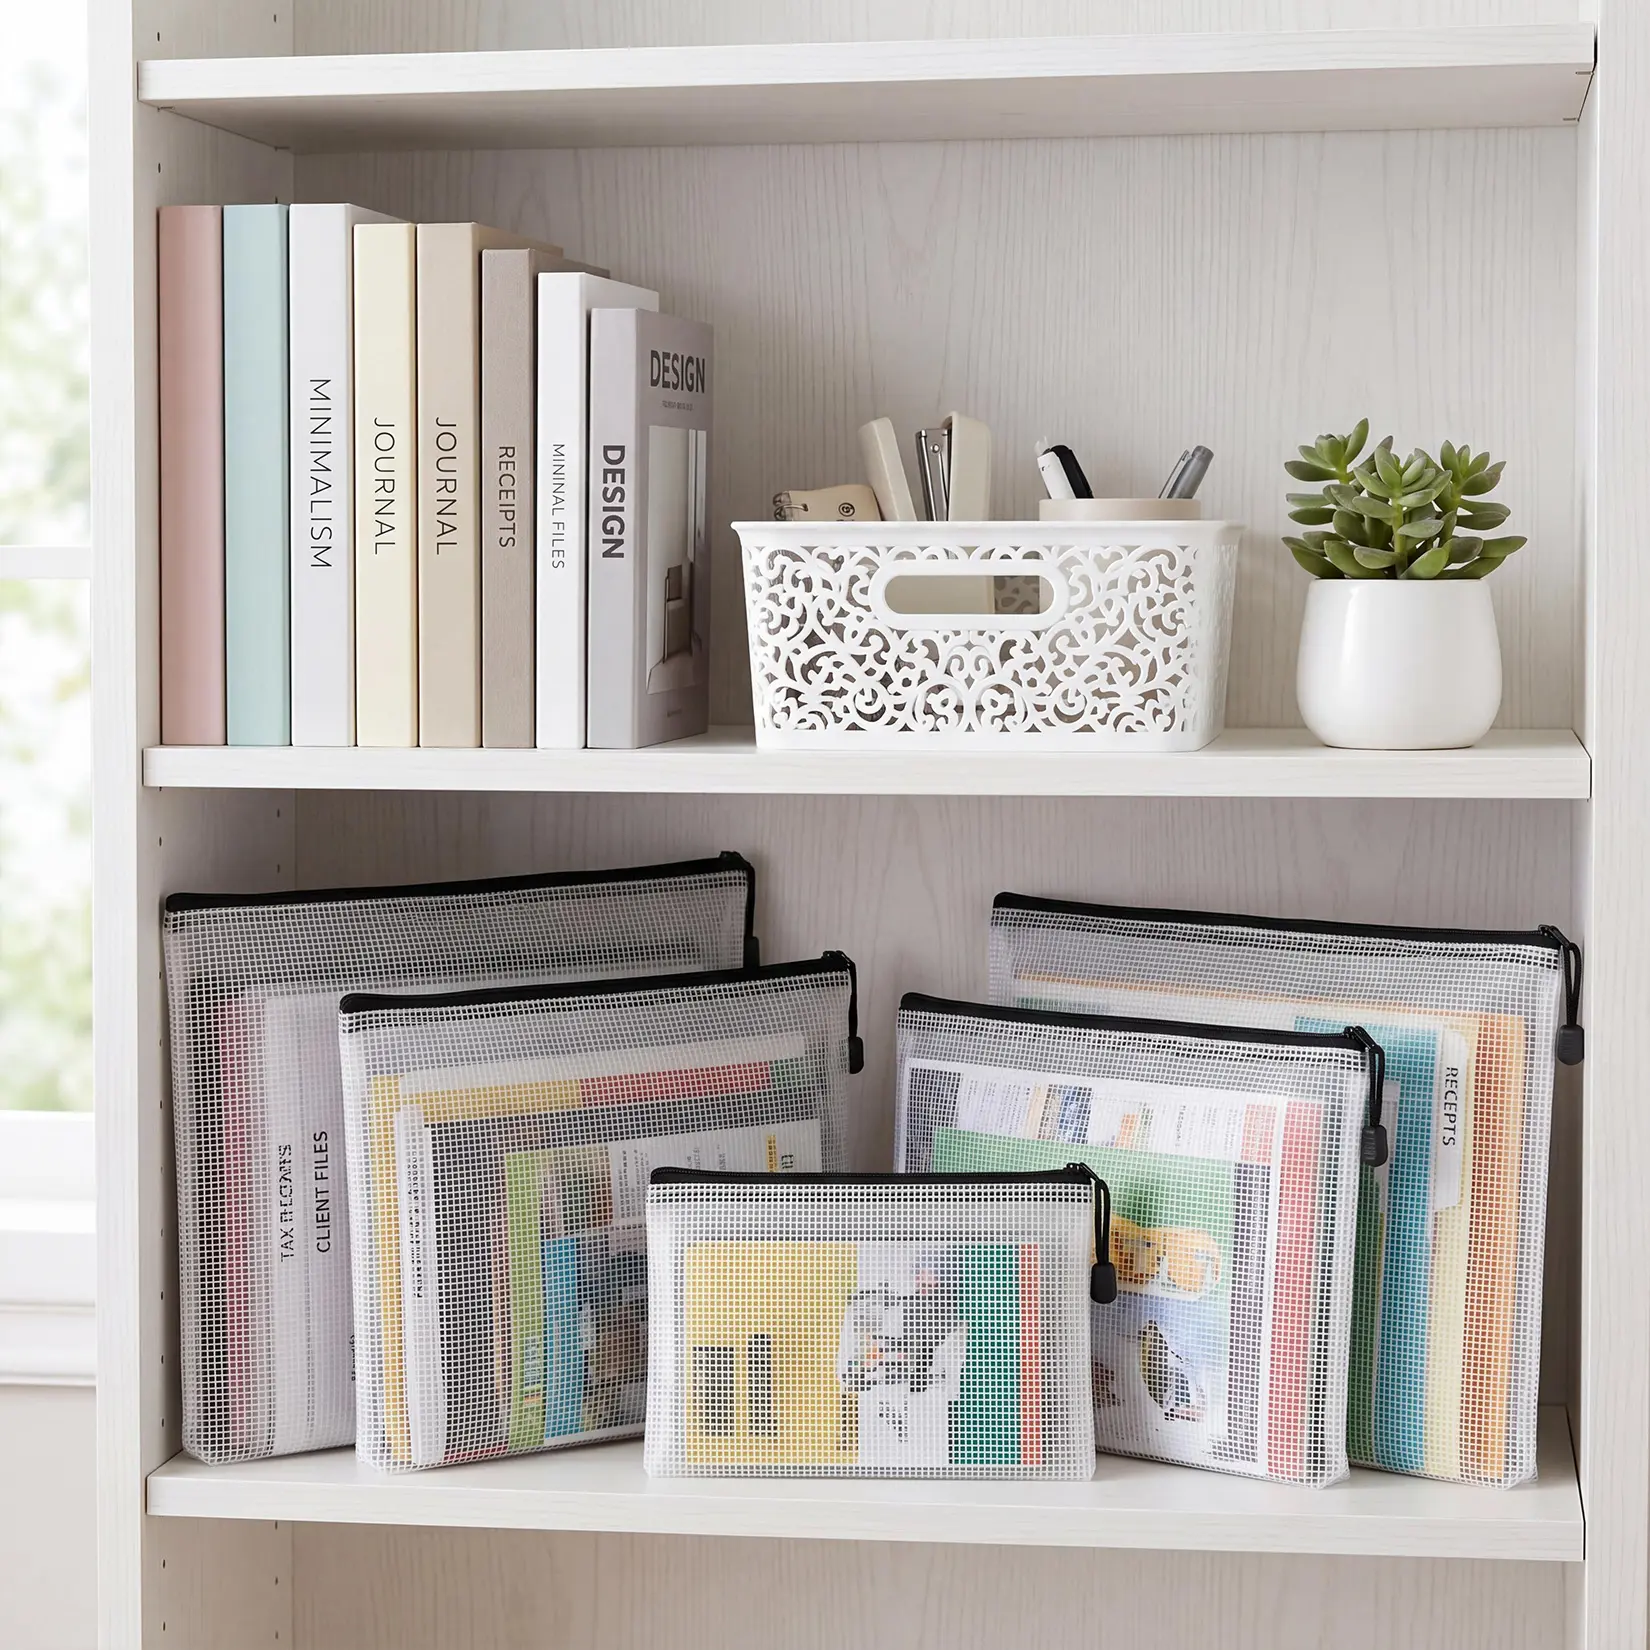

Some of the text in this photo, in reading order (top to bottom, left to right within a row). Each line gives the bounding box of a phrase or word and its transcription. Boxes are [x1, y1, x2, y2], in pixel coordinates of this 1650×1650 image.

[650, 349, 705, 394] DESIGN
[309, 379, 333, 568] MINIMALISM
[373, 417, 396, 555] JOURNAL
[435, 417, 458, 556] JOURNAL
[498, 446, 516, 548] RECEIPTS
[551, 443, 566, 570] MININAL FILES
[601, 444, 626, 559] DESIGN
[1442, 1067, 1459, 1146] RECEPTS
[279, 1226, 295, 1263] TAX
[313, 1130, 331, 1253] CLIENT FILES
